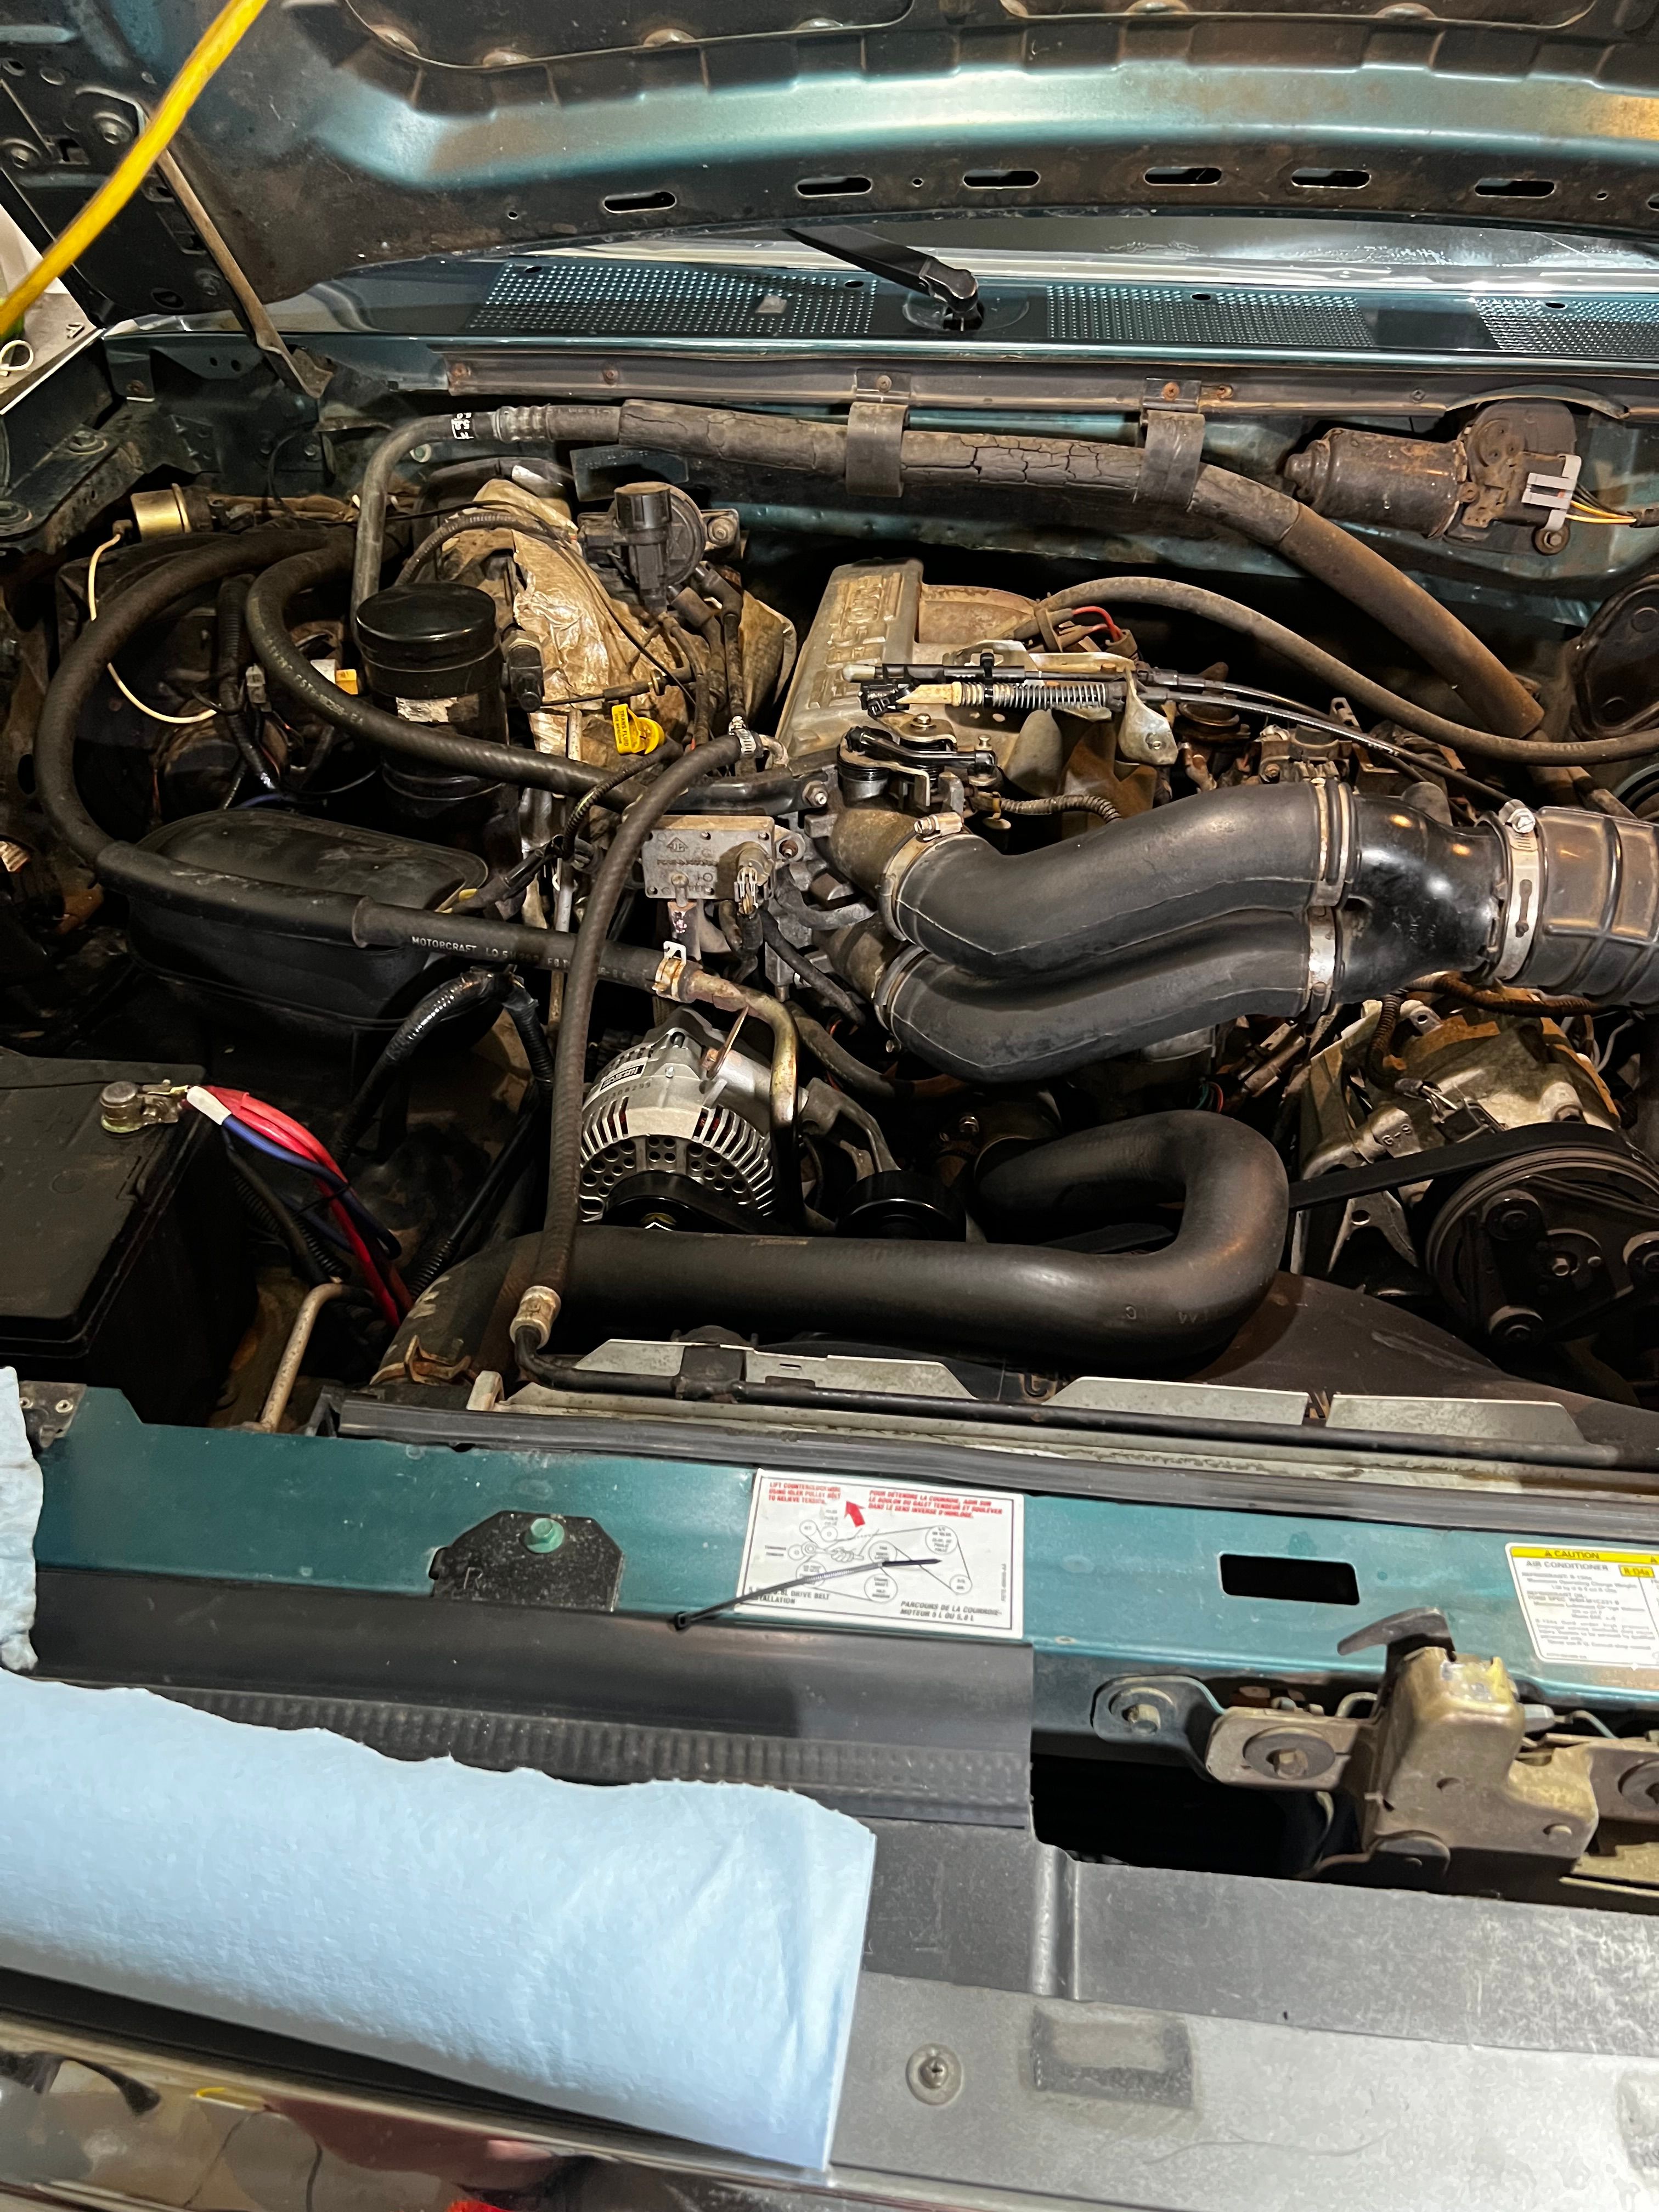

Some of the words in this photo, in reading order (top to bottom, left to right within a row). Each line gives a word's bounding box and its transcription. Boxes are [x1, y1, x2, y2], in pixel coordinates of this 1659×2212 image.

[411, 936, 477, 953] MOTORCRAFT
[1554, 1550, 1600, 1560] CAUTION
[1544, 1561, 1609, 1571] CONDITIONER
[791, 1590, 812, 1599] DRIVE
[900, 1600, 939, 1610] PARCOURS
[900, 1608, 930, 1617] MOTEUR
